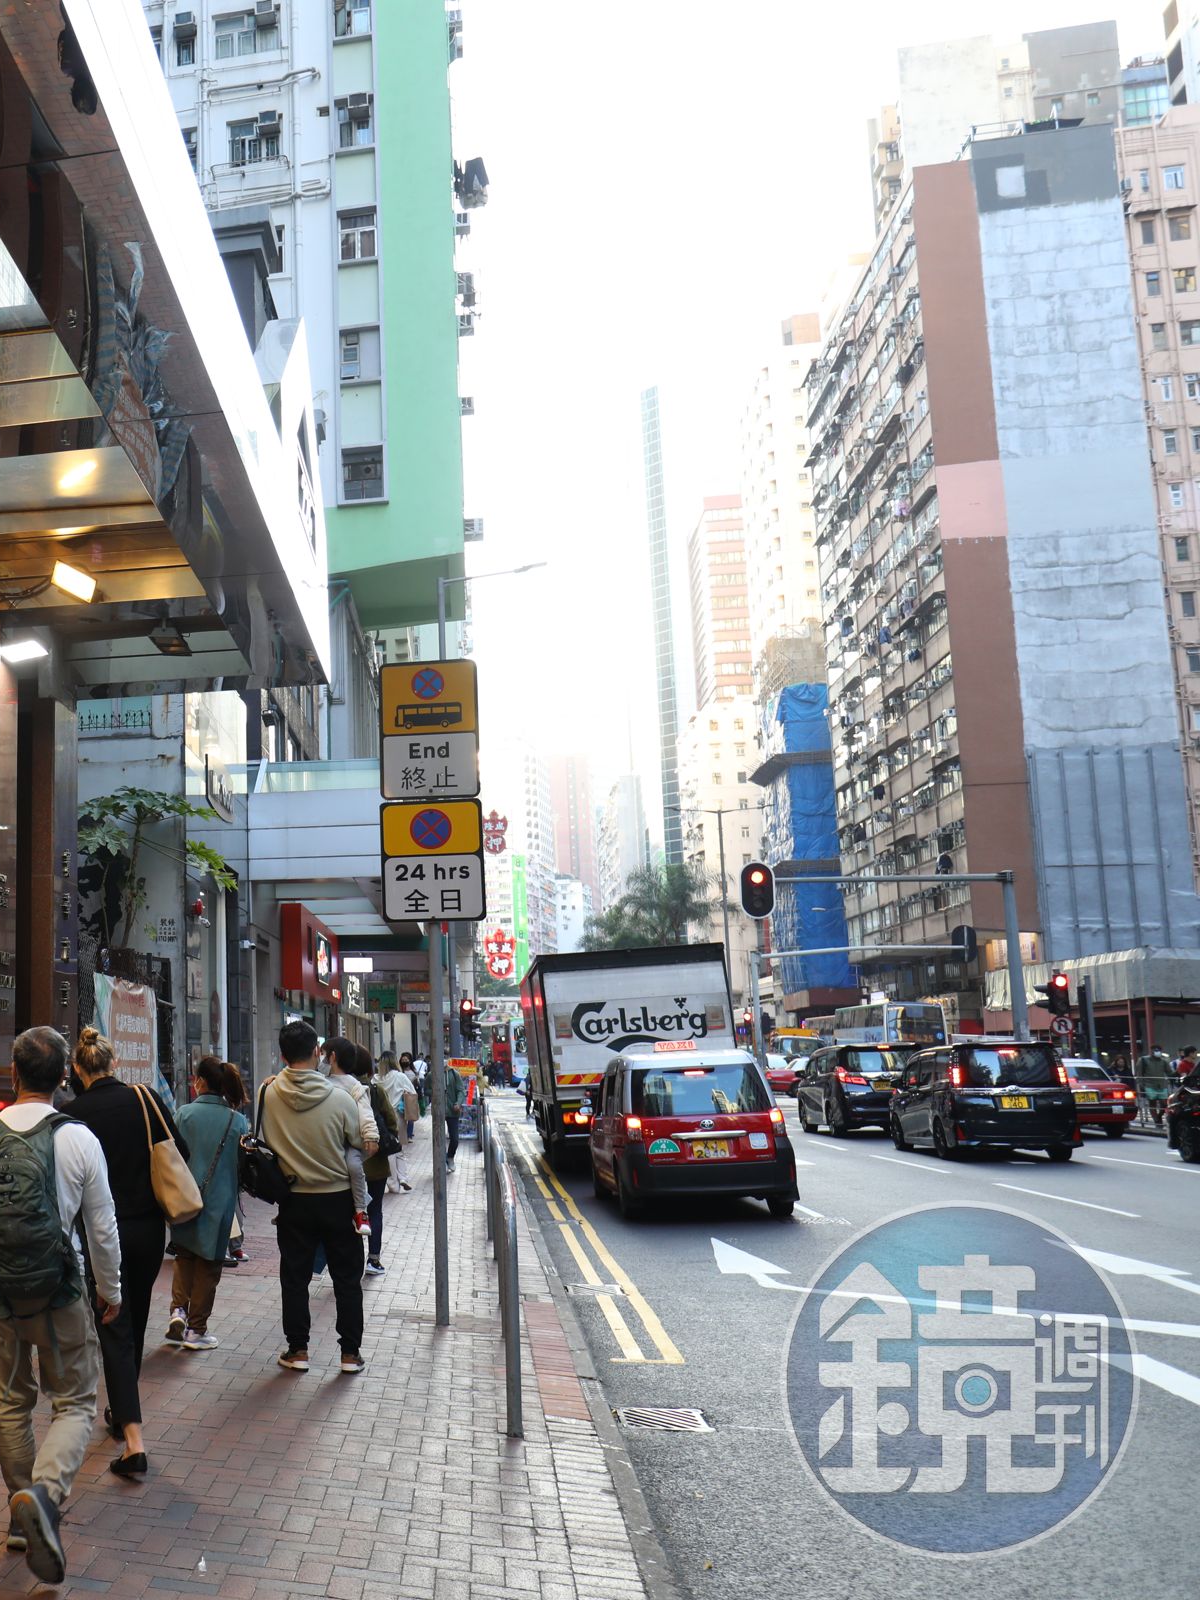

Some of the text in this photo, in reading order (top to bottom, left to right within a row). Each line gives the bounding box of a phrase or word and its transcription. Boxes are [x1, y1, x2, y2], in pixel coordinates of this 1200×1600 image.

[409, 742, 450, 759] End
[401, 766, 458, 790] 終止
[395, 863, 470, 882] 24 hrs
[404, 889, 462, 913] 全日
[571, 1001, 707, 1044] Carlsberg
[657, 1041, 694, 1050] TAXI
